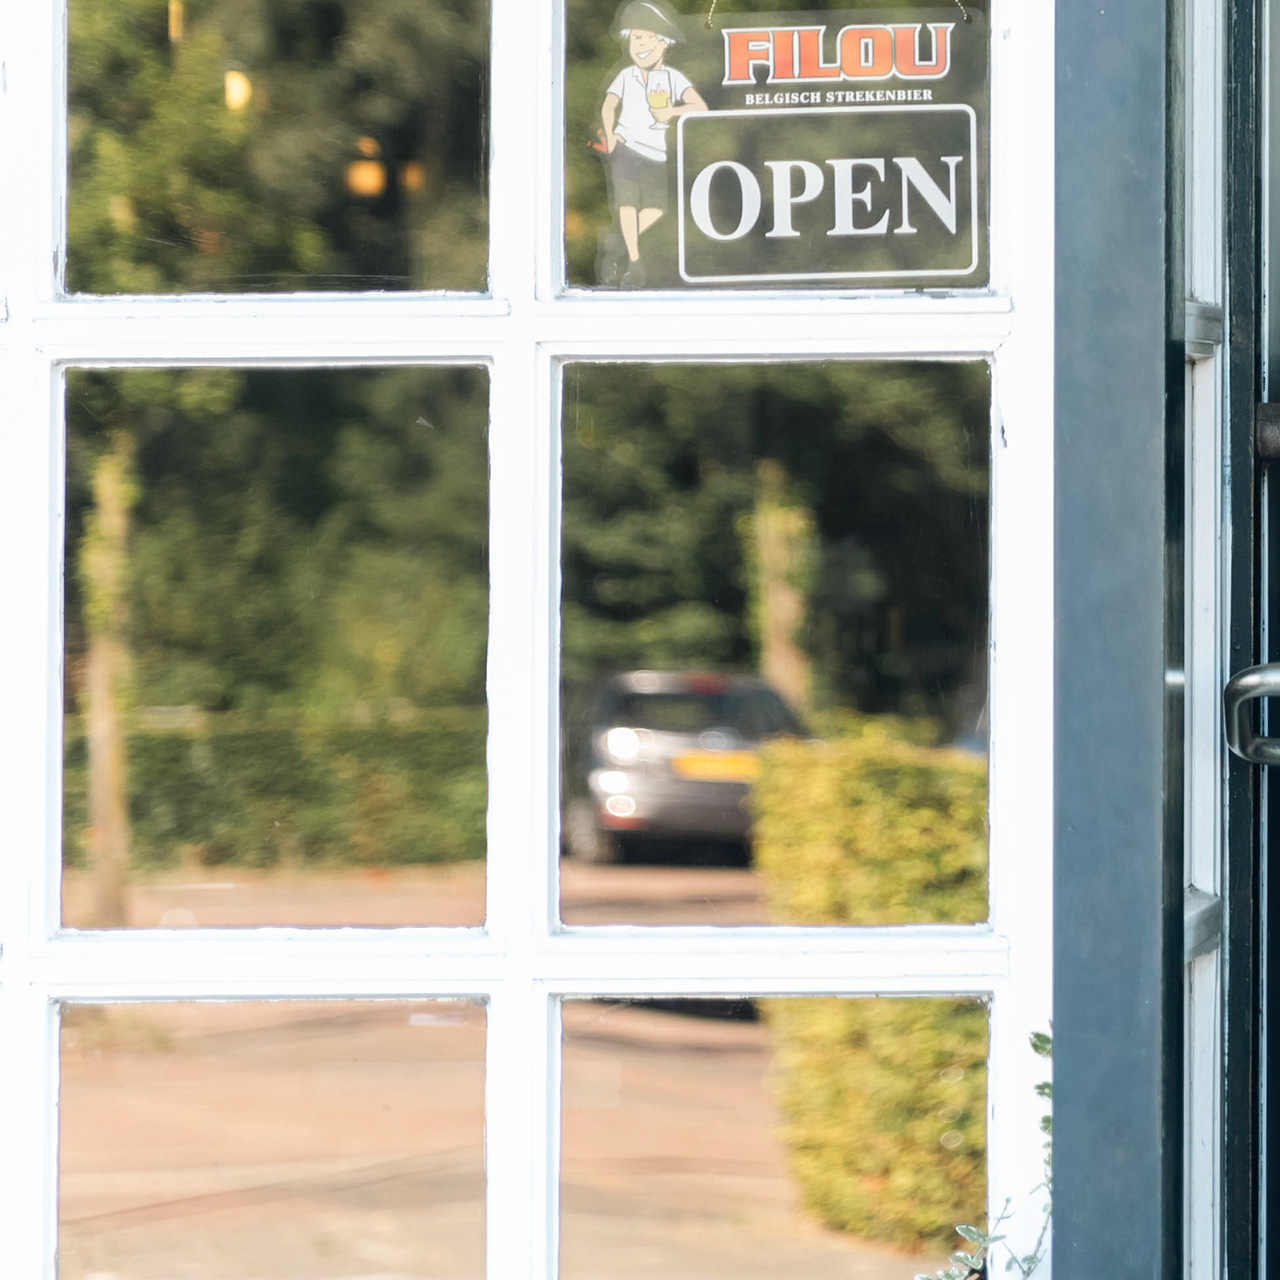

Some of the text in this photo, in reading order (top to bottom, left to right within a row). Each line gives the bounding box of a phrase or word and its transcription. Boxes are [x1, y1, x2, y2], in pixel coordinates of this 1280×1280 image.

[721, 22, 956, 86] FILOU
[744, 89, 933, 106] BELGISCH STREKENBIER
[689, 155, 963, 242] OPEN
